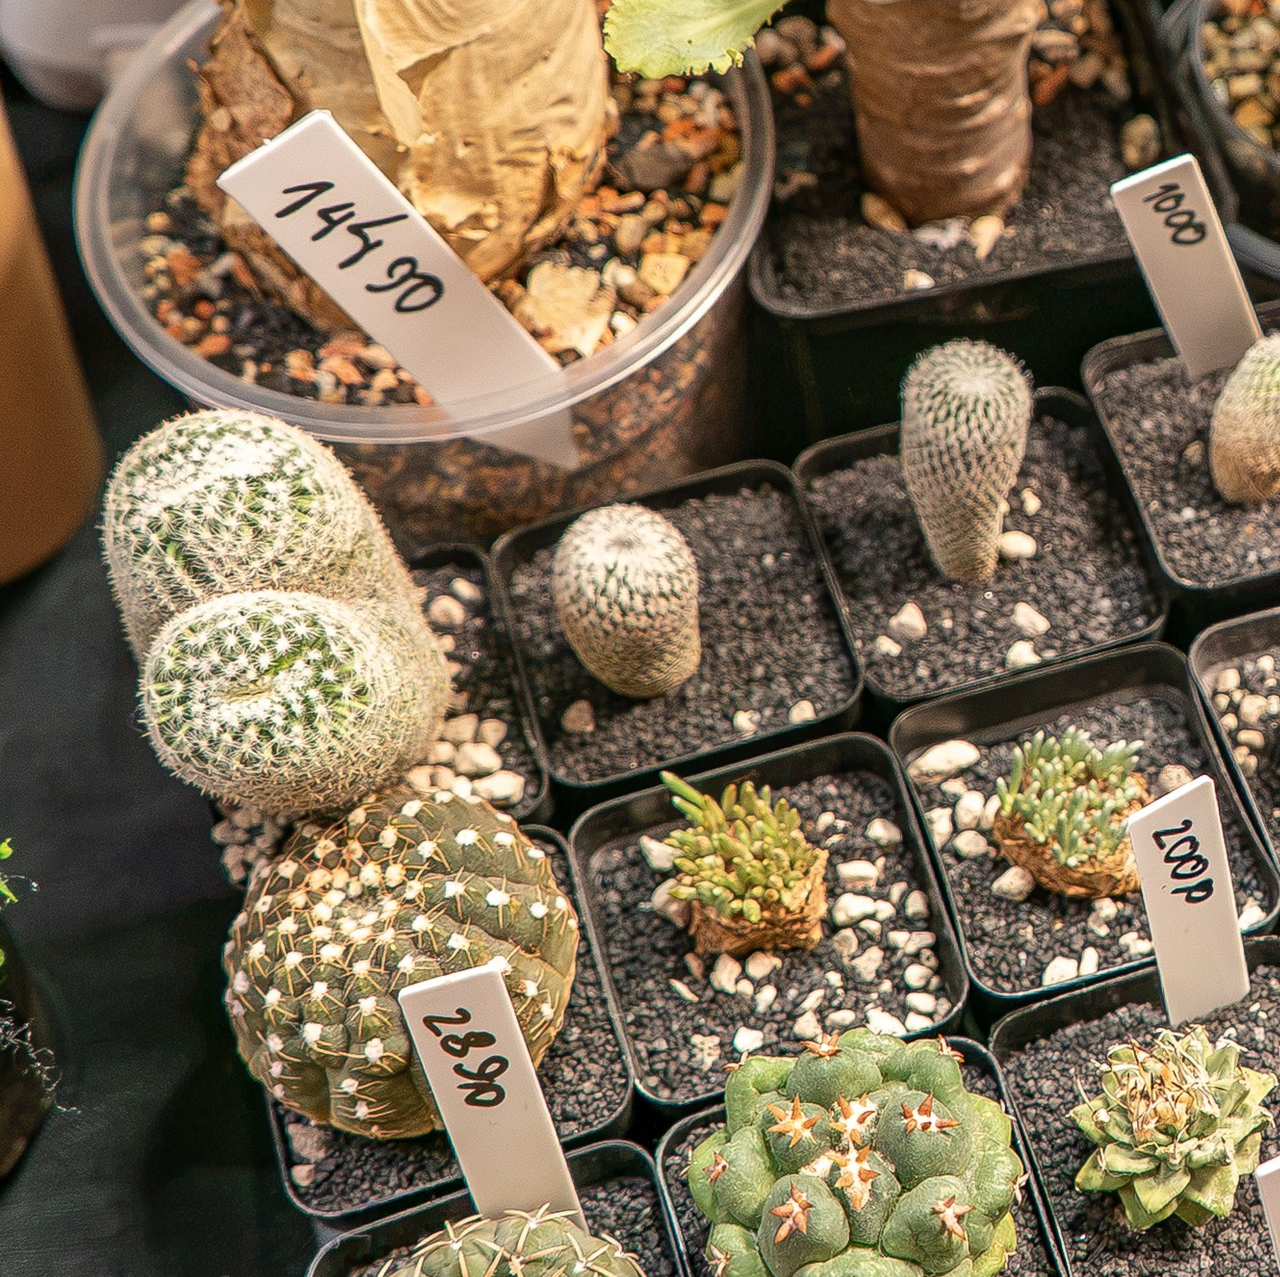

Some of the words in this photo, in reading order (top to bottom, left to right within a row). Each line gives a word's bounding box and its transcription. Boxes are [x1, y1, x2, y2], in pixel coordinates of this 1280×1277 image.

[274, 181, 444, 314] 14490
[1142, 183, 1206, 245] 1000
[1151, 819, 1214, 904] 2000
[422, 1006, 510, 1108] 2890
